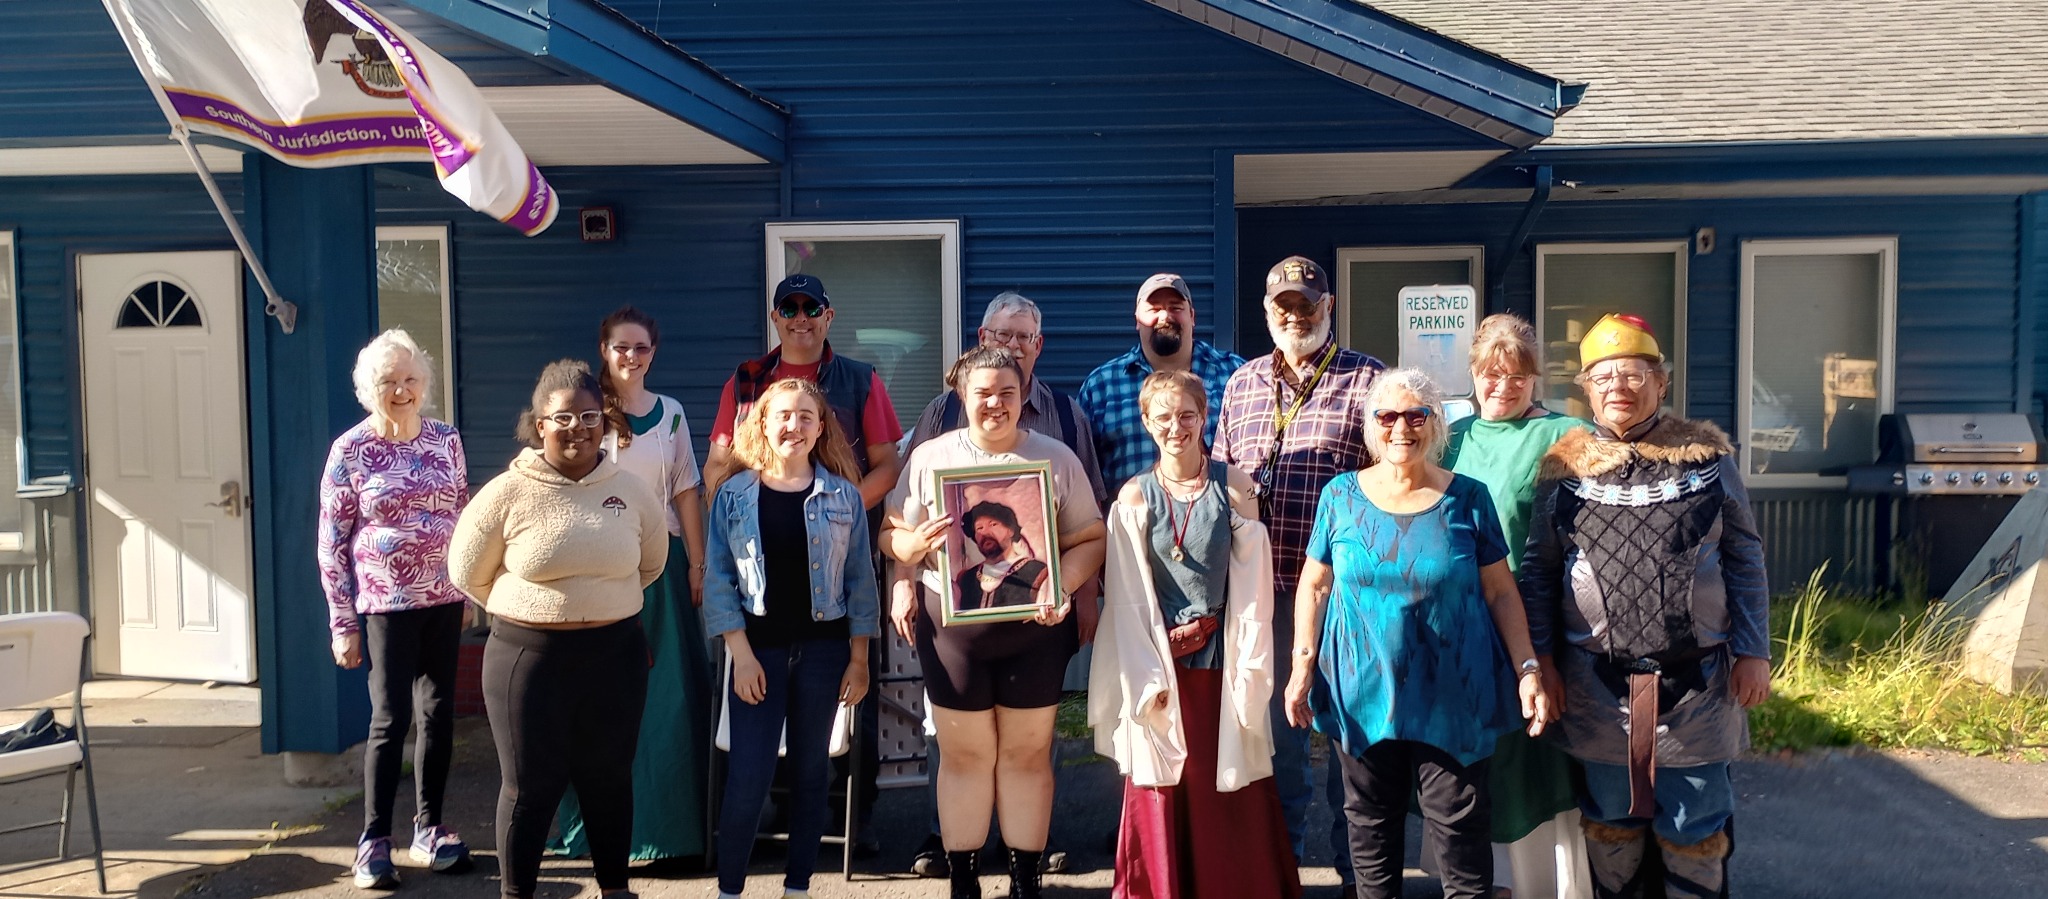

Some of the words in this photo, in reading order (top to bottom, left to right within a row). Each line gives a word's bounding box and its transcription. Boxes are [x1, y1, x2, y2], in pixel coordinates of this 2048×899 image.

[205, 105, 273, 143] Southern
[278, 127, 387, 149] Jurisdiction,
[1406, 296, 1469, 311] RESERVED
[1409, 315, 1465, 330] PARKING
